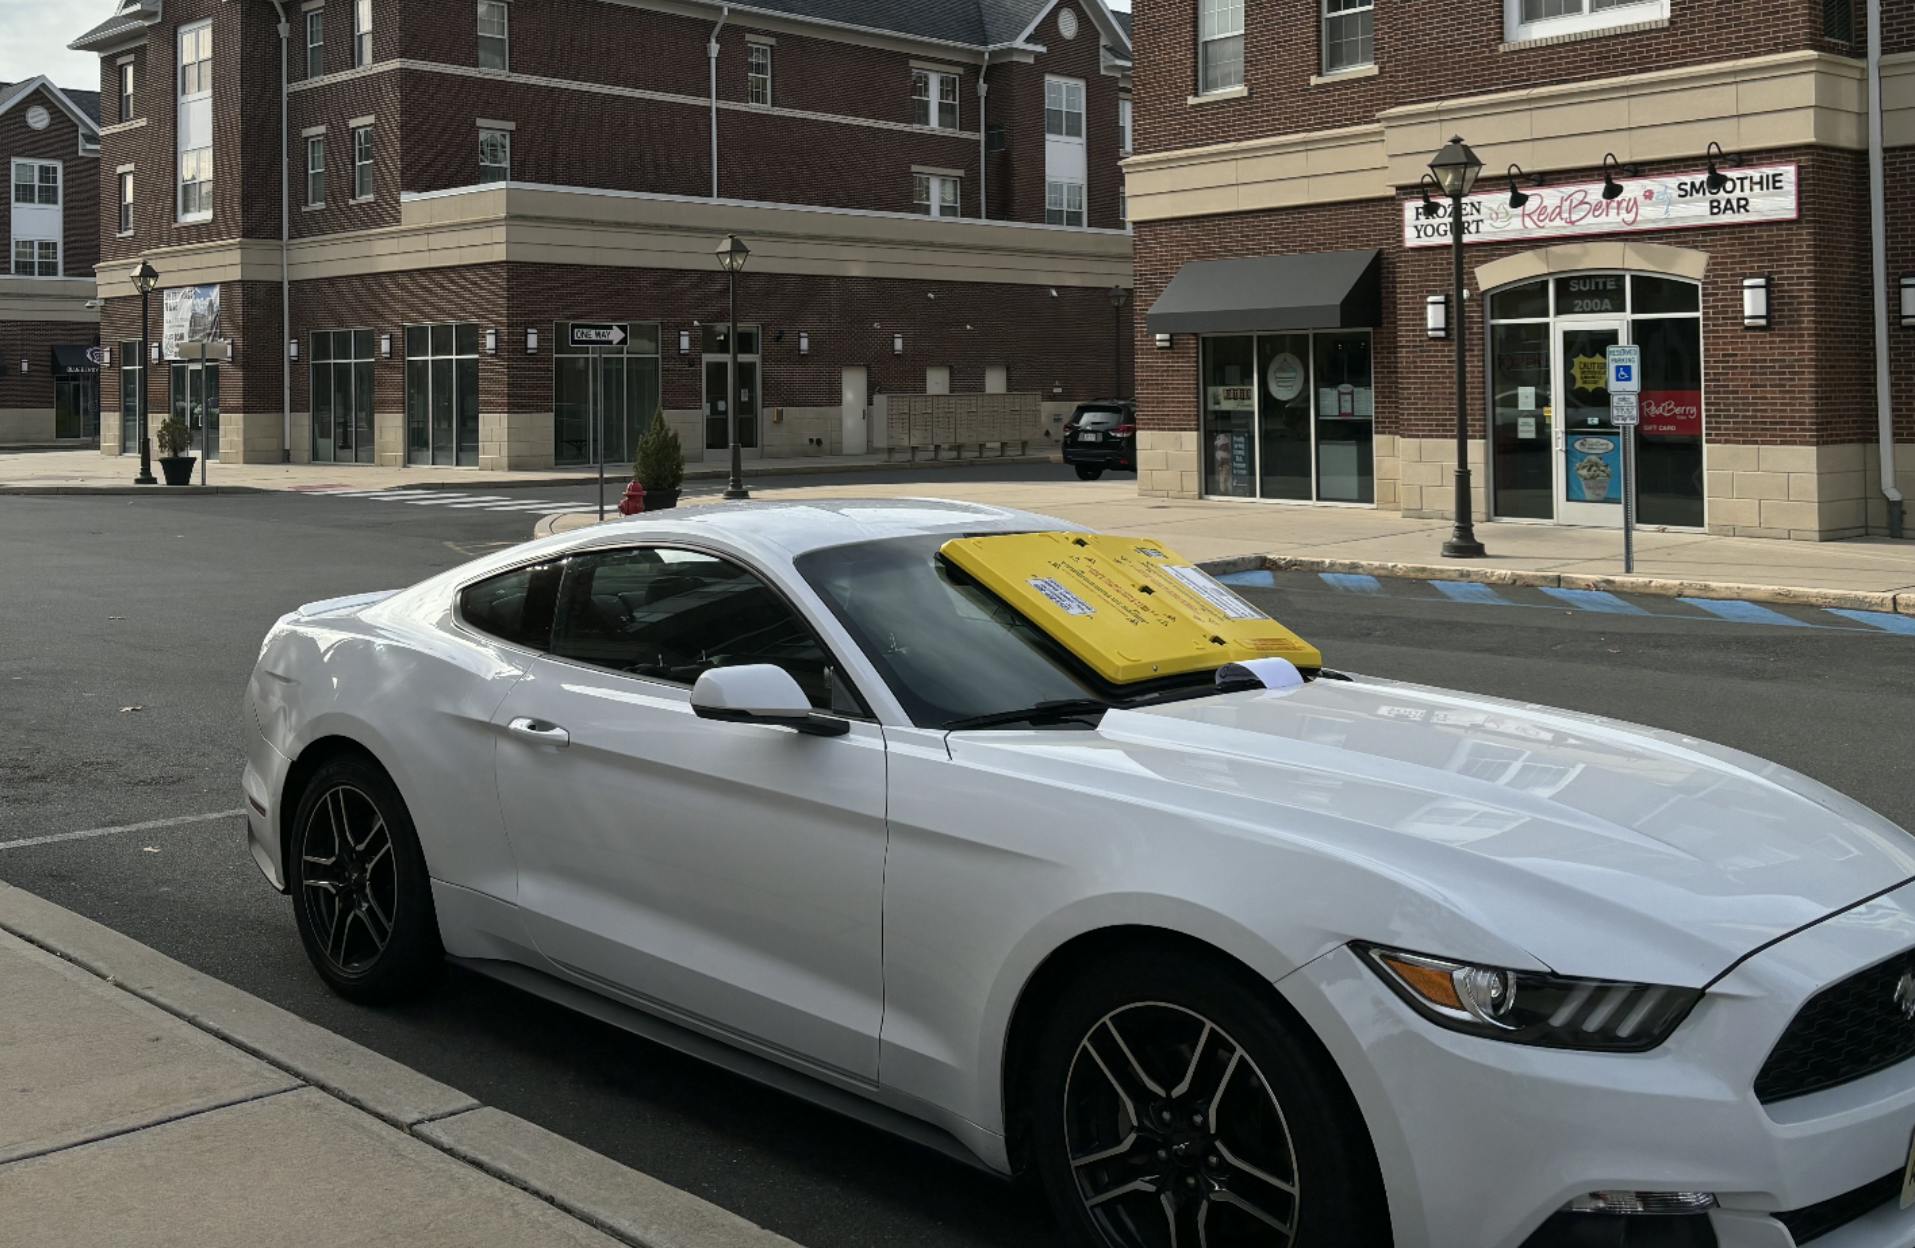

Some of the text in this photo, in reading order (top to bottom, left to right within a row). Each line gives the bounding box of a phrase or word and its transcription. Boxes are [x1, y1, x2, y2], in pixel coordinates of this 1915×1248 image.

[1522, 189, 1638, 228] RedBerry
[1709, 197, 1750, 215] BAR
[1569, 278, 1616, 291] SUITE
[1573, 298, 1613, 312] 200A
[575, 329, 611, 339] ONE WAY
